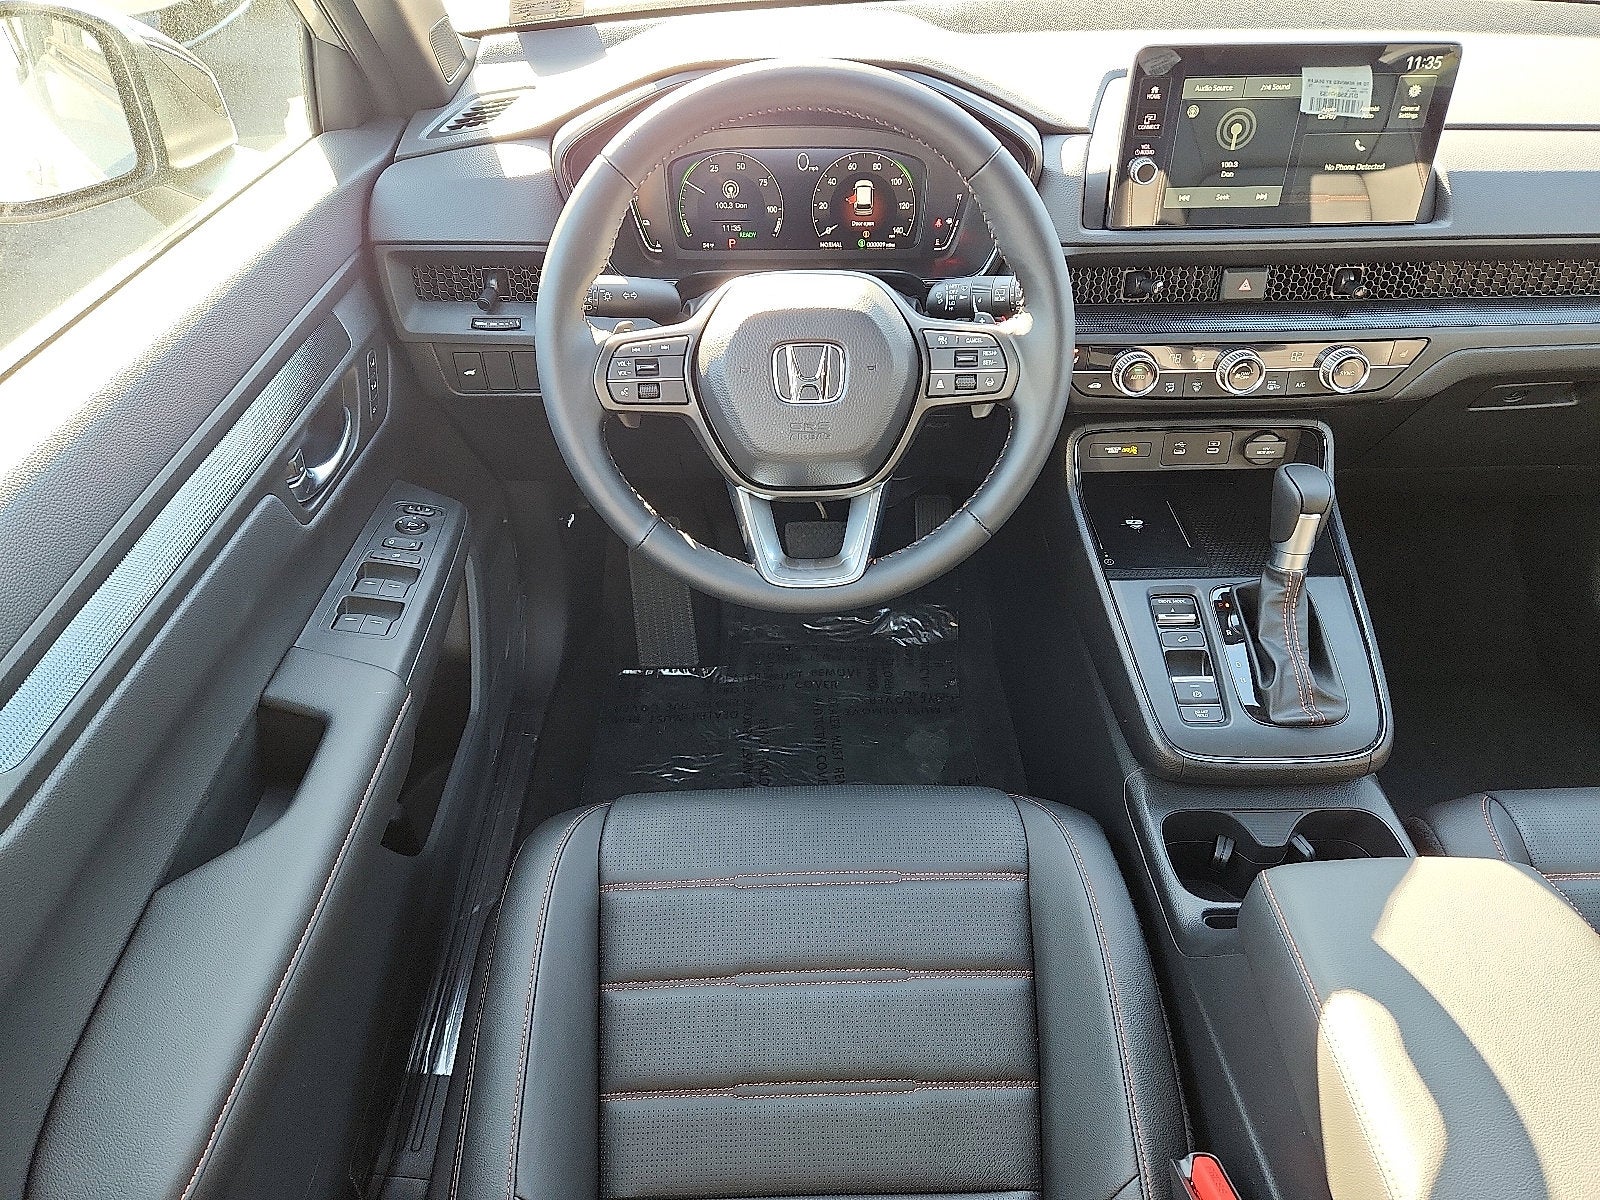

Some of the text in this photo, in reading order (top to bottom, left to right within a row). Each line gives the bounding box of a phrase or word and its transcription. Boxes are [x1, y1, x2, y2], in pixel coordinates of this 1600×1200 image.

[1406, 56, 1443, 70] 11:35
[798, 153, 809, 171] 0
[728, 239, 736, 248] P
[794, 680, 839, 690] COVER
[831, 736, 844, 760] MUST
